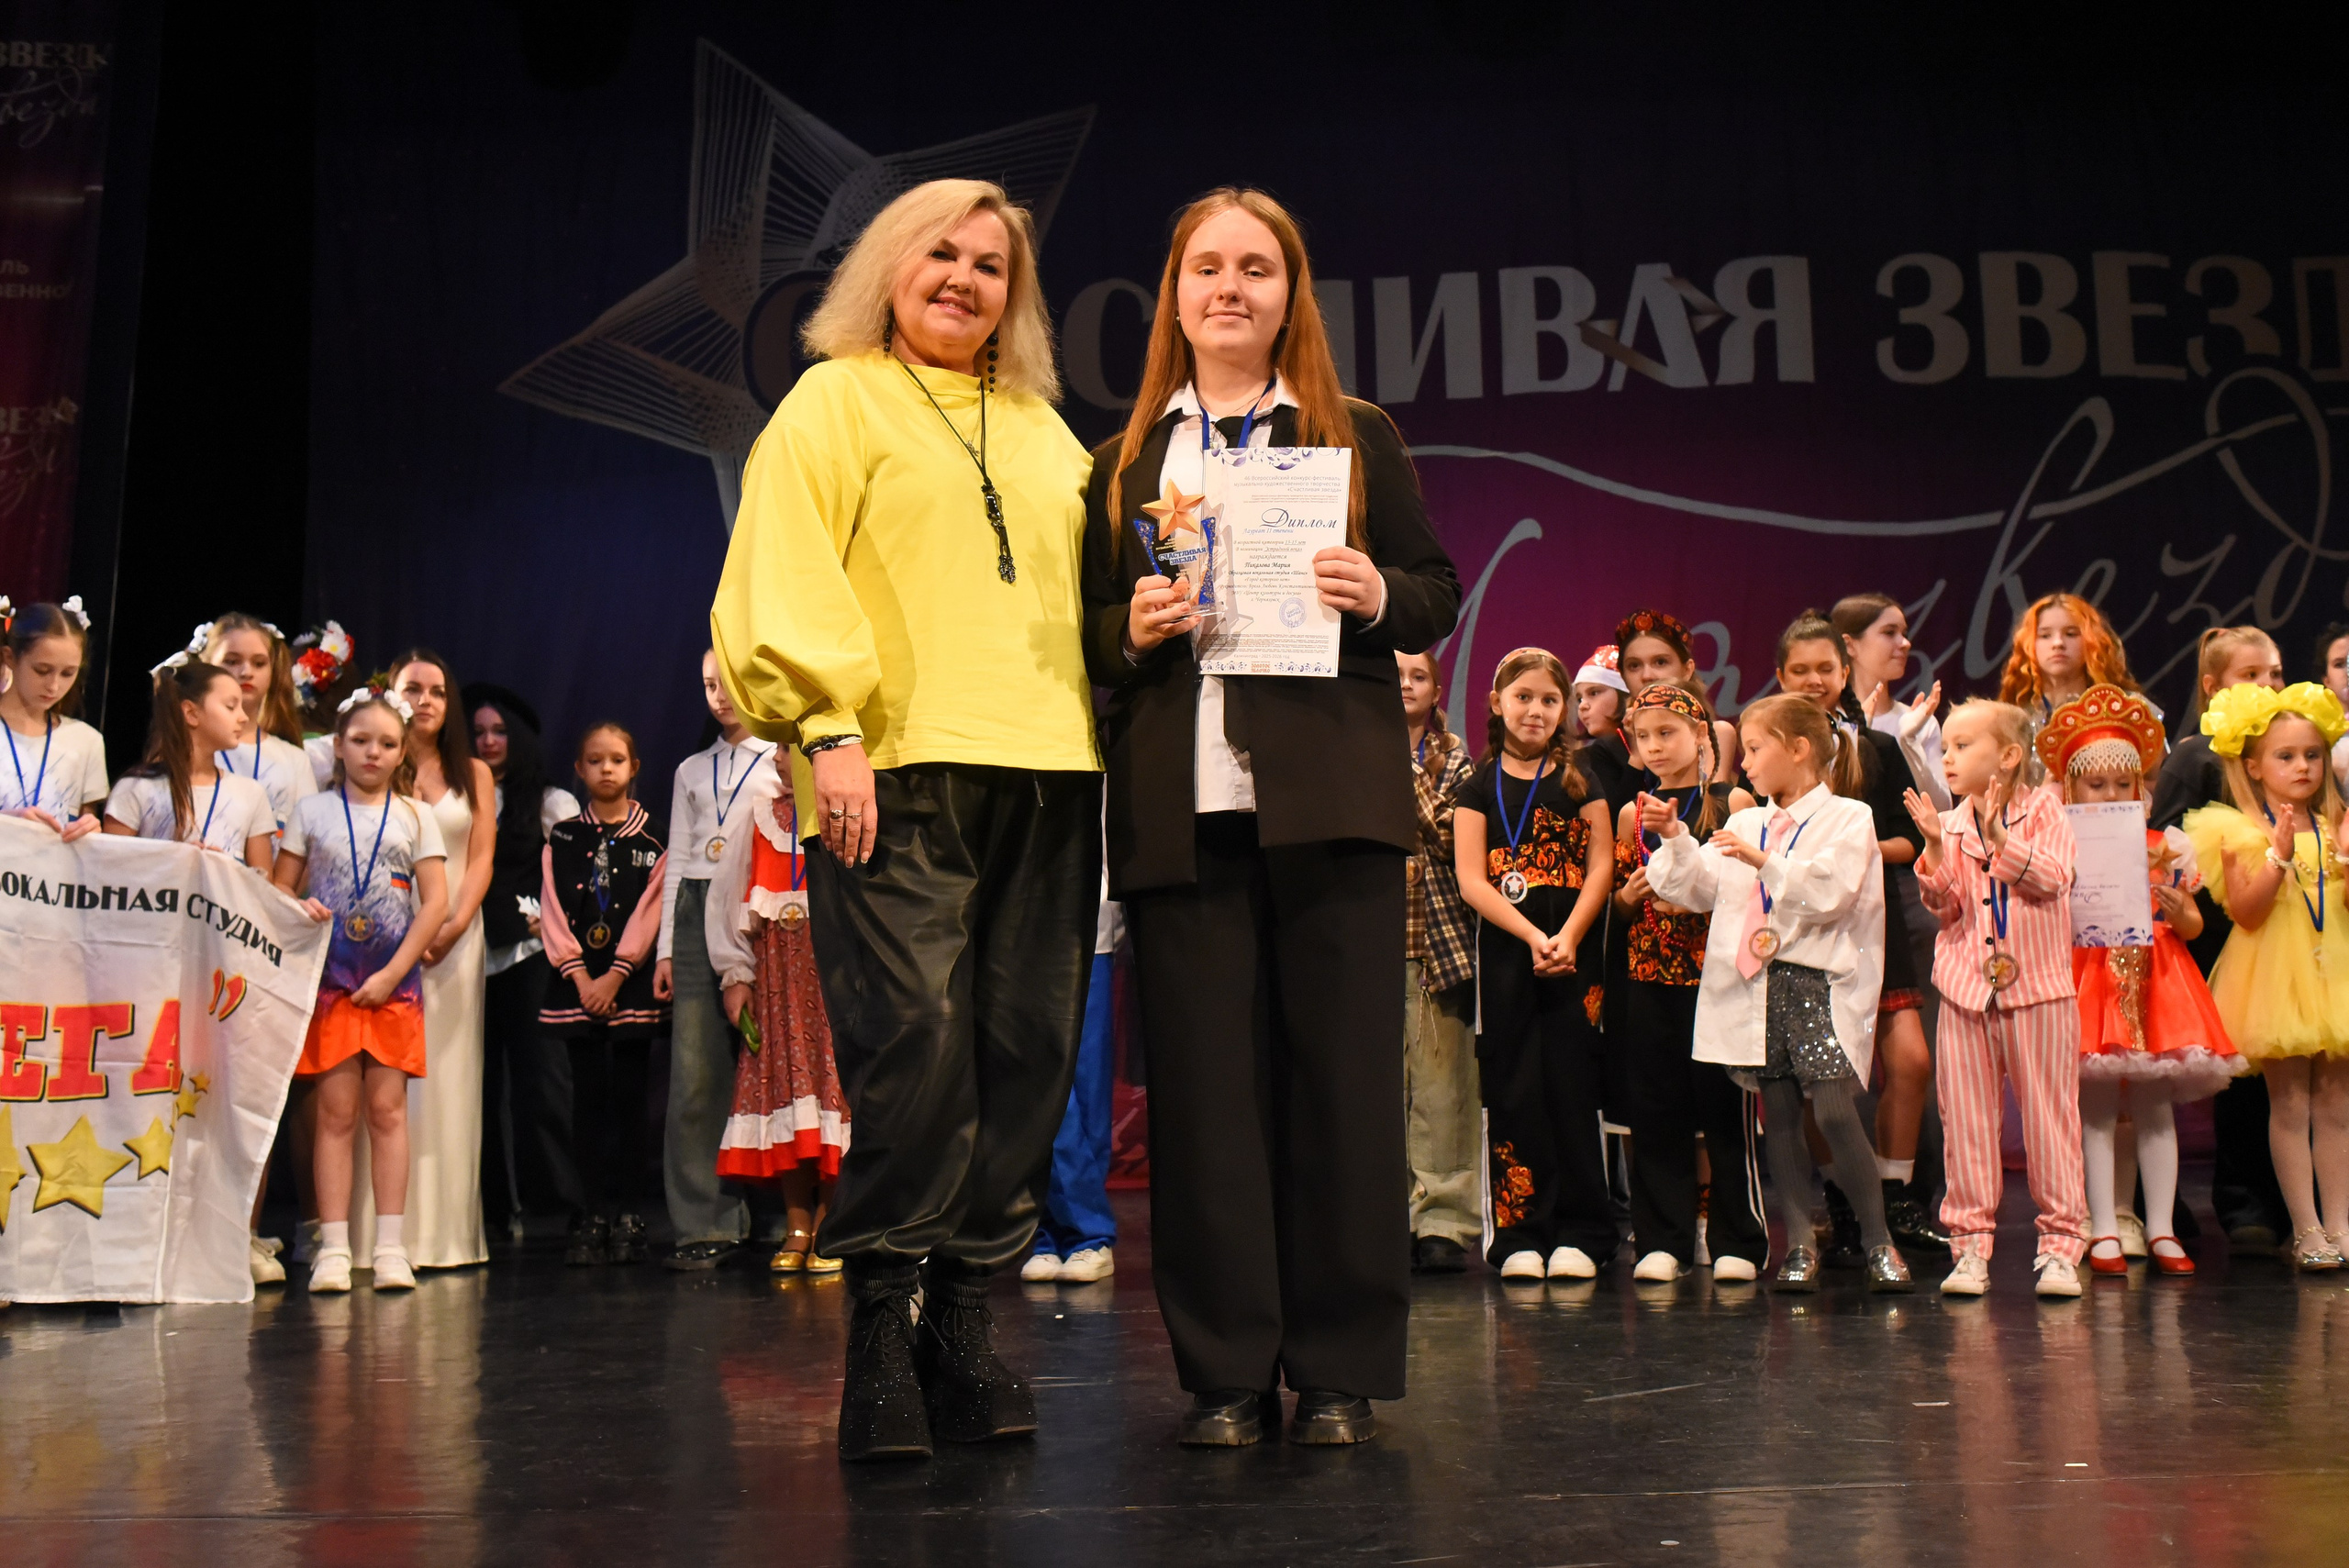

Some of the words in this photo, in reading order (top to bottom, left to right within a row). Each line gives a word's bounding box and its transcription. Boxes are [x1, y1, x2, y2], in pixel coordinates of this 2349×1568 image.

[1260, 507, 1338, 528] Диплом
[1158, 548, 1207, 561] СЧАСТЛИВАЯ
[1170, 556, 1197, 565] ЗВЕЗДА
[631, 849, 657, 867] 196
[0, 871, 179, 913] ОКАЛЬНАЯ
[186, 893, 283, 968] СТУДИЯ
